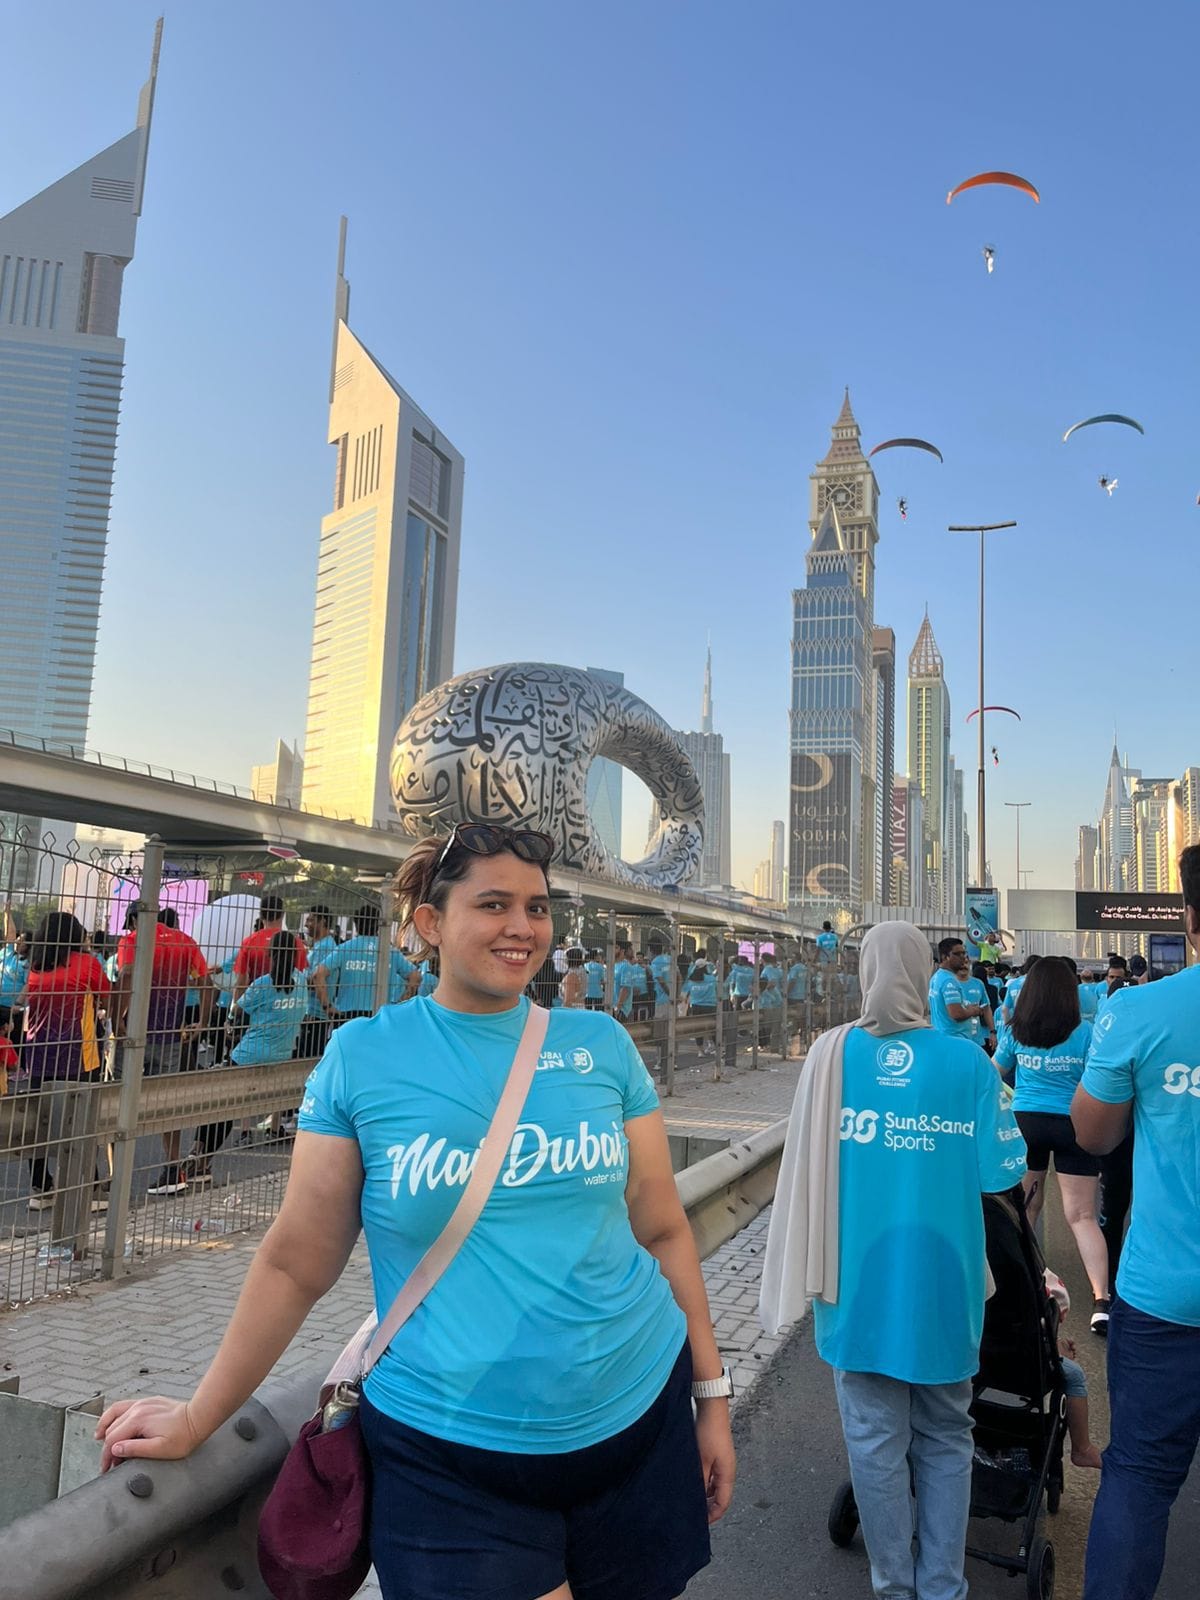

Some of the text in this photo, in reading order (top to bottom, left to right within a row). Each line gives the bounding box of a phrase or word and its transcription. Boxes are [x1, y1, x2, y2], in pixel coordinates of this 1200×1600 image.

[793, 829, 848, 842] SOBHA
[540, 1051, 562, 1060] UBAI
[536, 1059, 565, 1070] UN
[884, 1111, 975, 1137] Sun&Sand
[884, 1130, 936, 1152] Sports
[502, 1121, 625, 1187] Dubai
[583, 1173, 609, 1186] water
[610, 1170, 616, 1182] is
